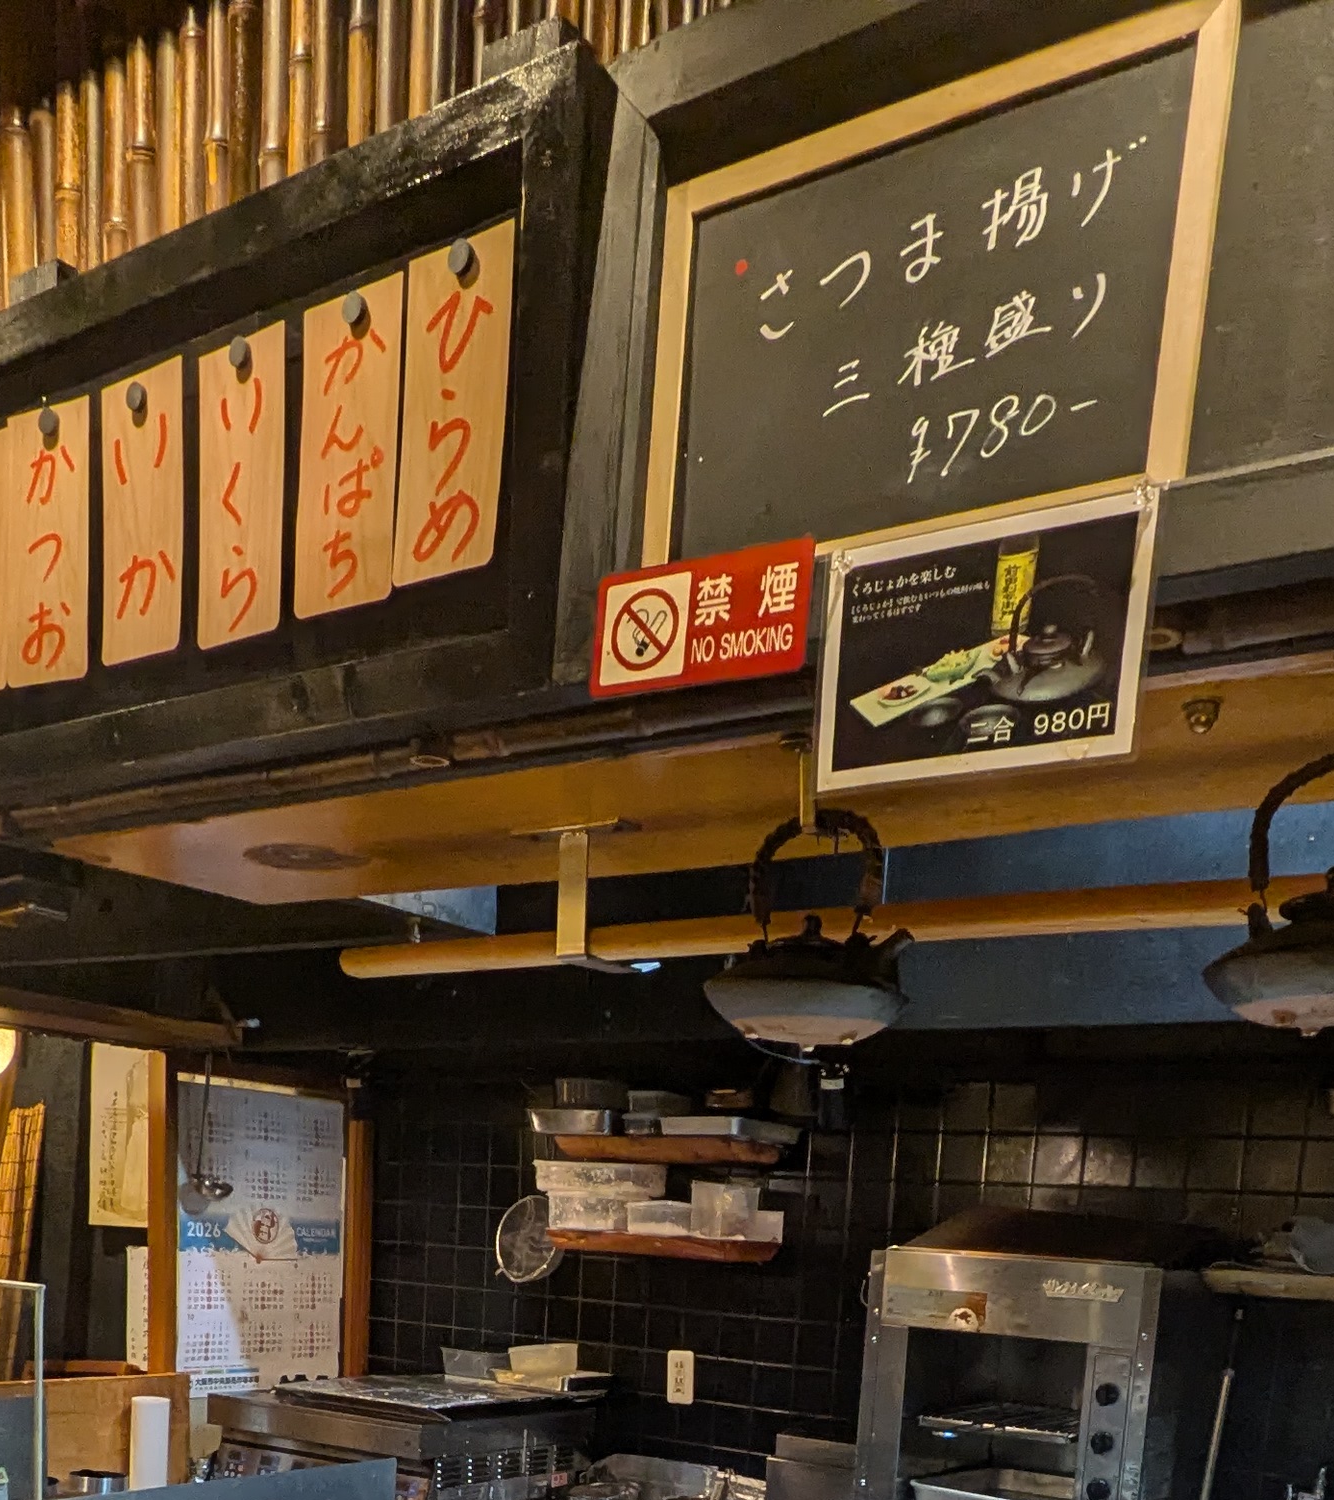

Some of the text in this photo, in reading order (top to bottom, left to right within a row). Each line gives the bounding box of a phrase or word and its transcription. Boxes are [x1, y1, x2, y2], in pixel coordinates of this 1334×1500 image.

[759, 134, 1148, 341] さつま揚げ
[411, 291, 495, 564] ひらめ
[822, 272, 1108, 417] 三種盛り
[115, 413, 176, 621] いか
[219, 376, 263, 633] いくら
[320, 328, 387, 599] かんぱち
[21, 445, 75, 670] かつお
[690, 623, 794, 664] NO SMOKING
[695, 561, 800, 626] 禁煙
[967, 702, 1111, 743] 二合 980円
[187, 1220, 221, 1238] 2026
[296, 1225, 337, 1239] CALENDAR
